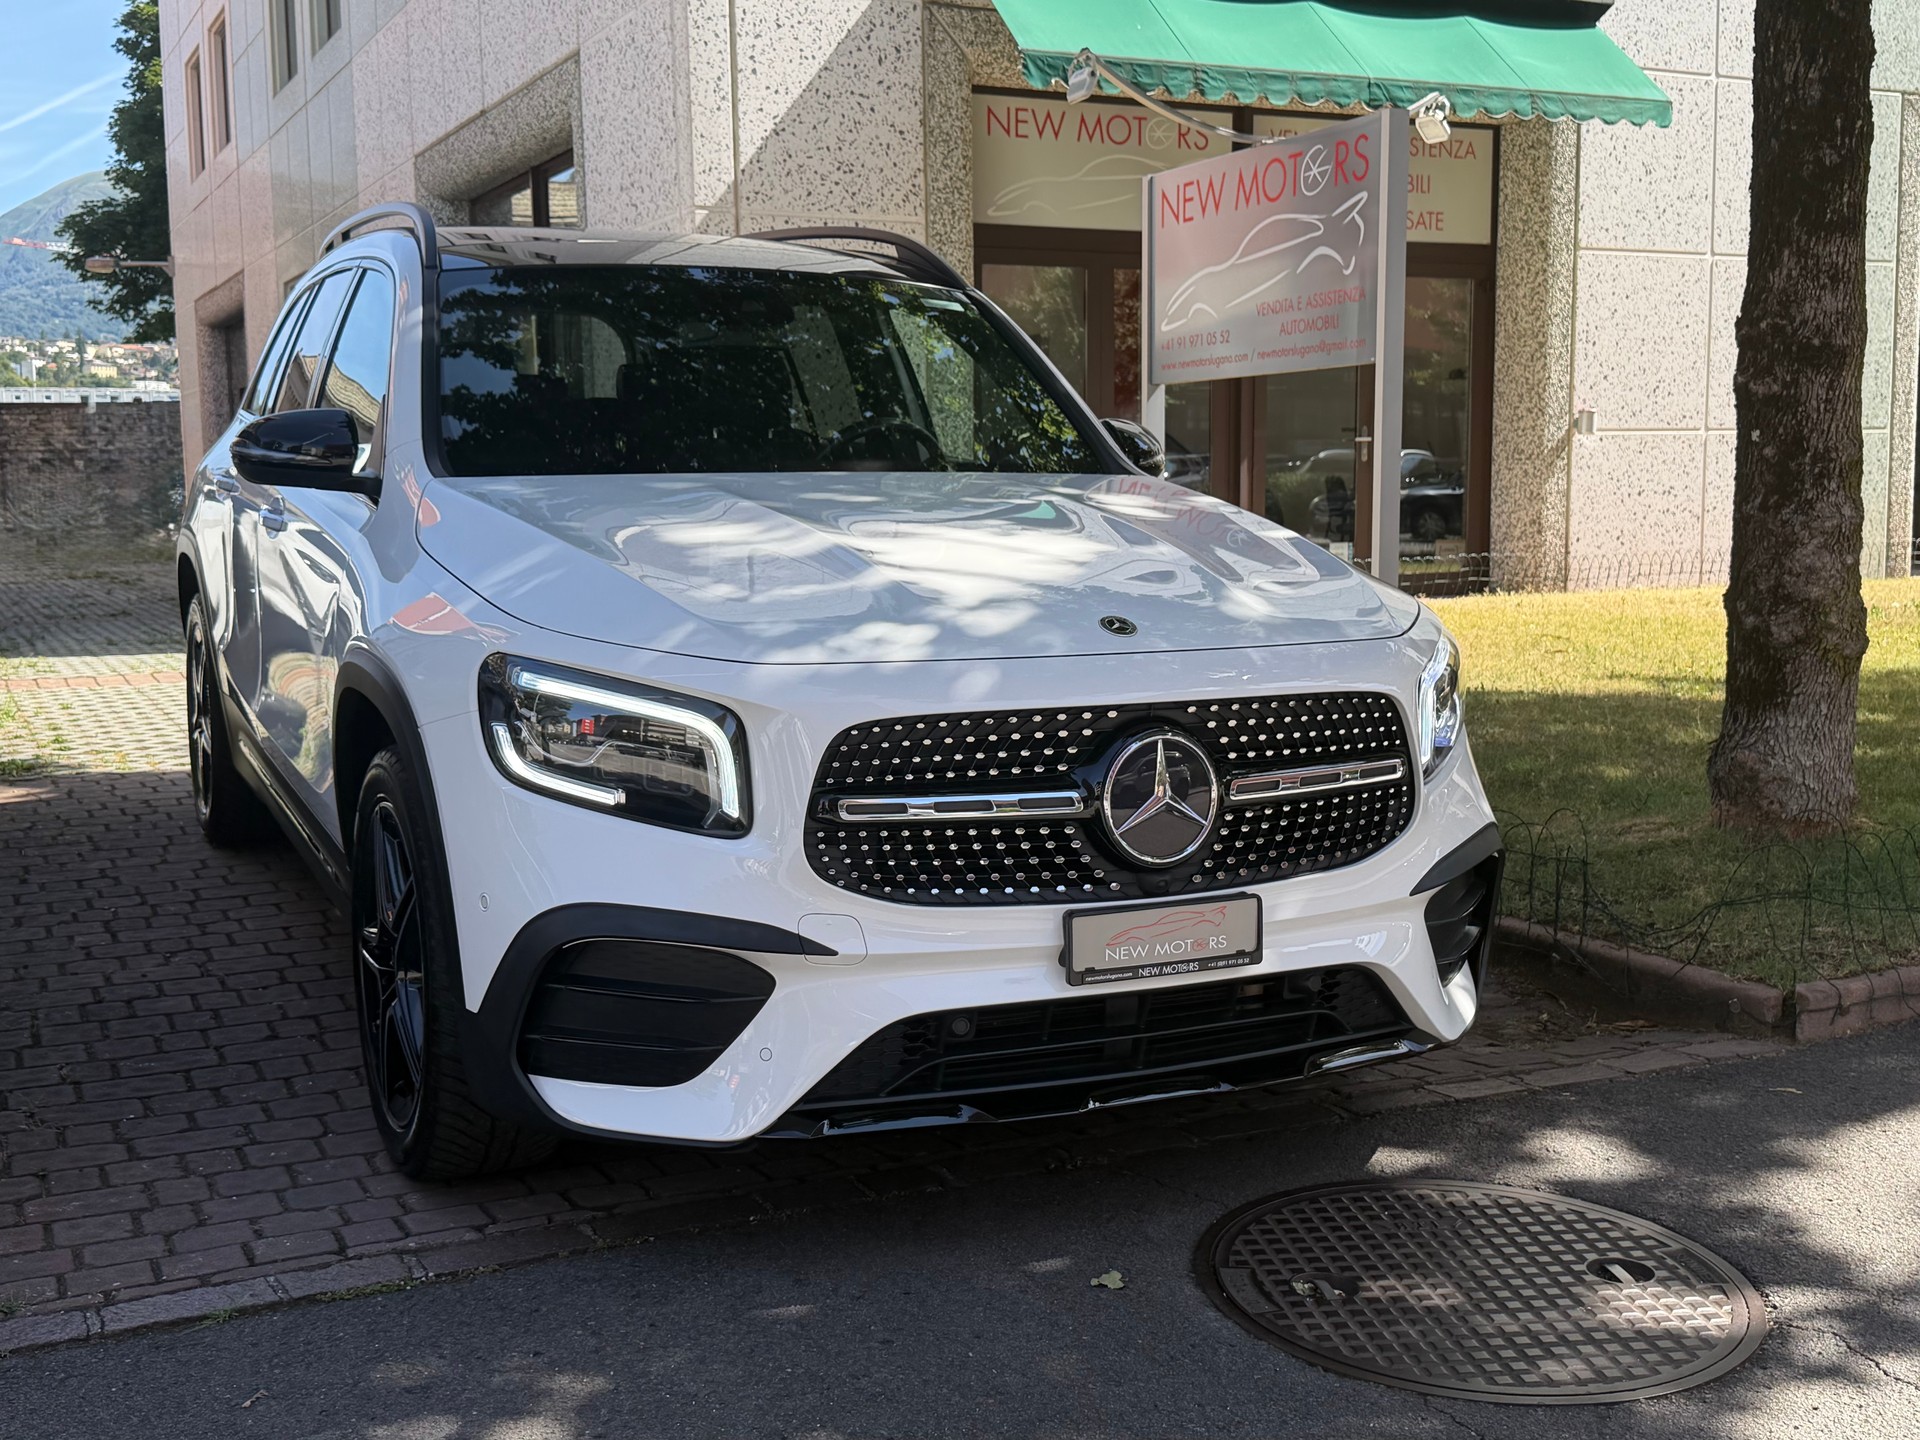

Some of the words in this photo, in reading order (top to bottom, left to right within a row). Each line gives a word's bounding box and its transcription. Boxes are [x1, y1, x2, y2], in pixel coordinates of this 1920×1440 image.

[987, 105, 1066, 142] NEW
[1409, 137, 1477, 160] STENZA
[1161, 172, 1226, 229] NEW
[1234, 133, 1370, 211] MOTORS
[1408, 174, 1431, 194] BILI
[1406, 210, 1444, 231] SATE
[1256, 298, 1294, 317] VENDITA
[1305, 284, 1367, 310] ASSISTENZA
[1279, 313, 1340, 337] AUTOMOBILI
[1161, 337, 1174, 351] +41
[1176, 335, 1186, 349] 91
[1189, 333, 1204, 348] 971
[1206, 331, 1218, 346] 05
[1219, 329, 1231, 344] 52
[1161, 353, 1249, 371] www.newmotorslugano.com
[1256, 336, 1367, 360] newmotorslugano@gmail.com
[1105, 944, 1150, 961] NEW
[1154, 935, 1227, 957] MOTORS
[1138, 966, 1160, 978] NEW
[1162, 961, 1200, 975] MOTORS
